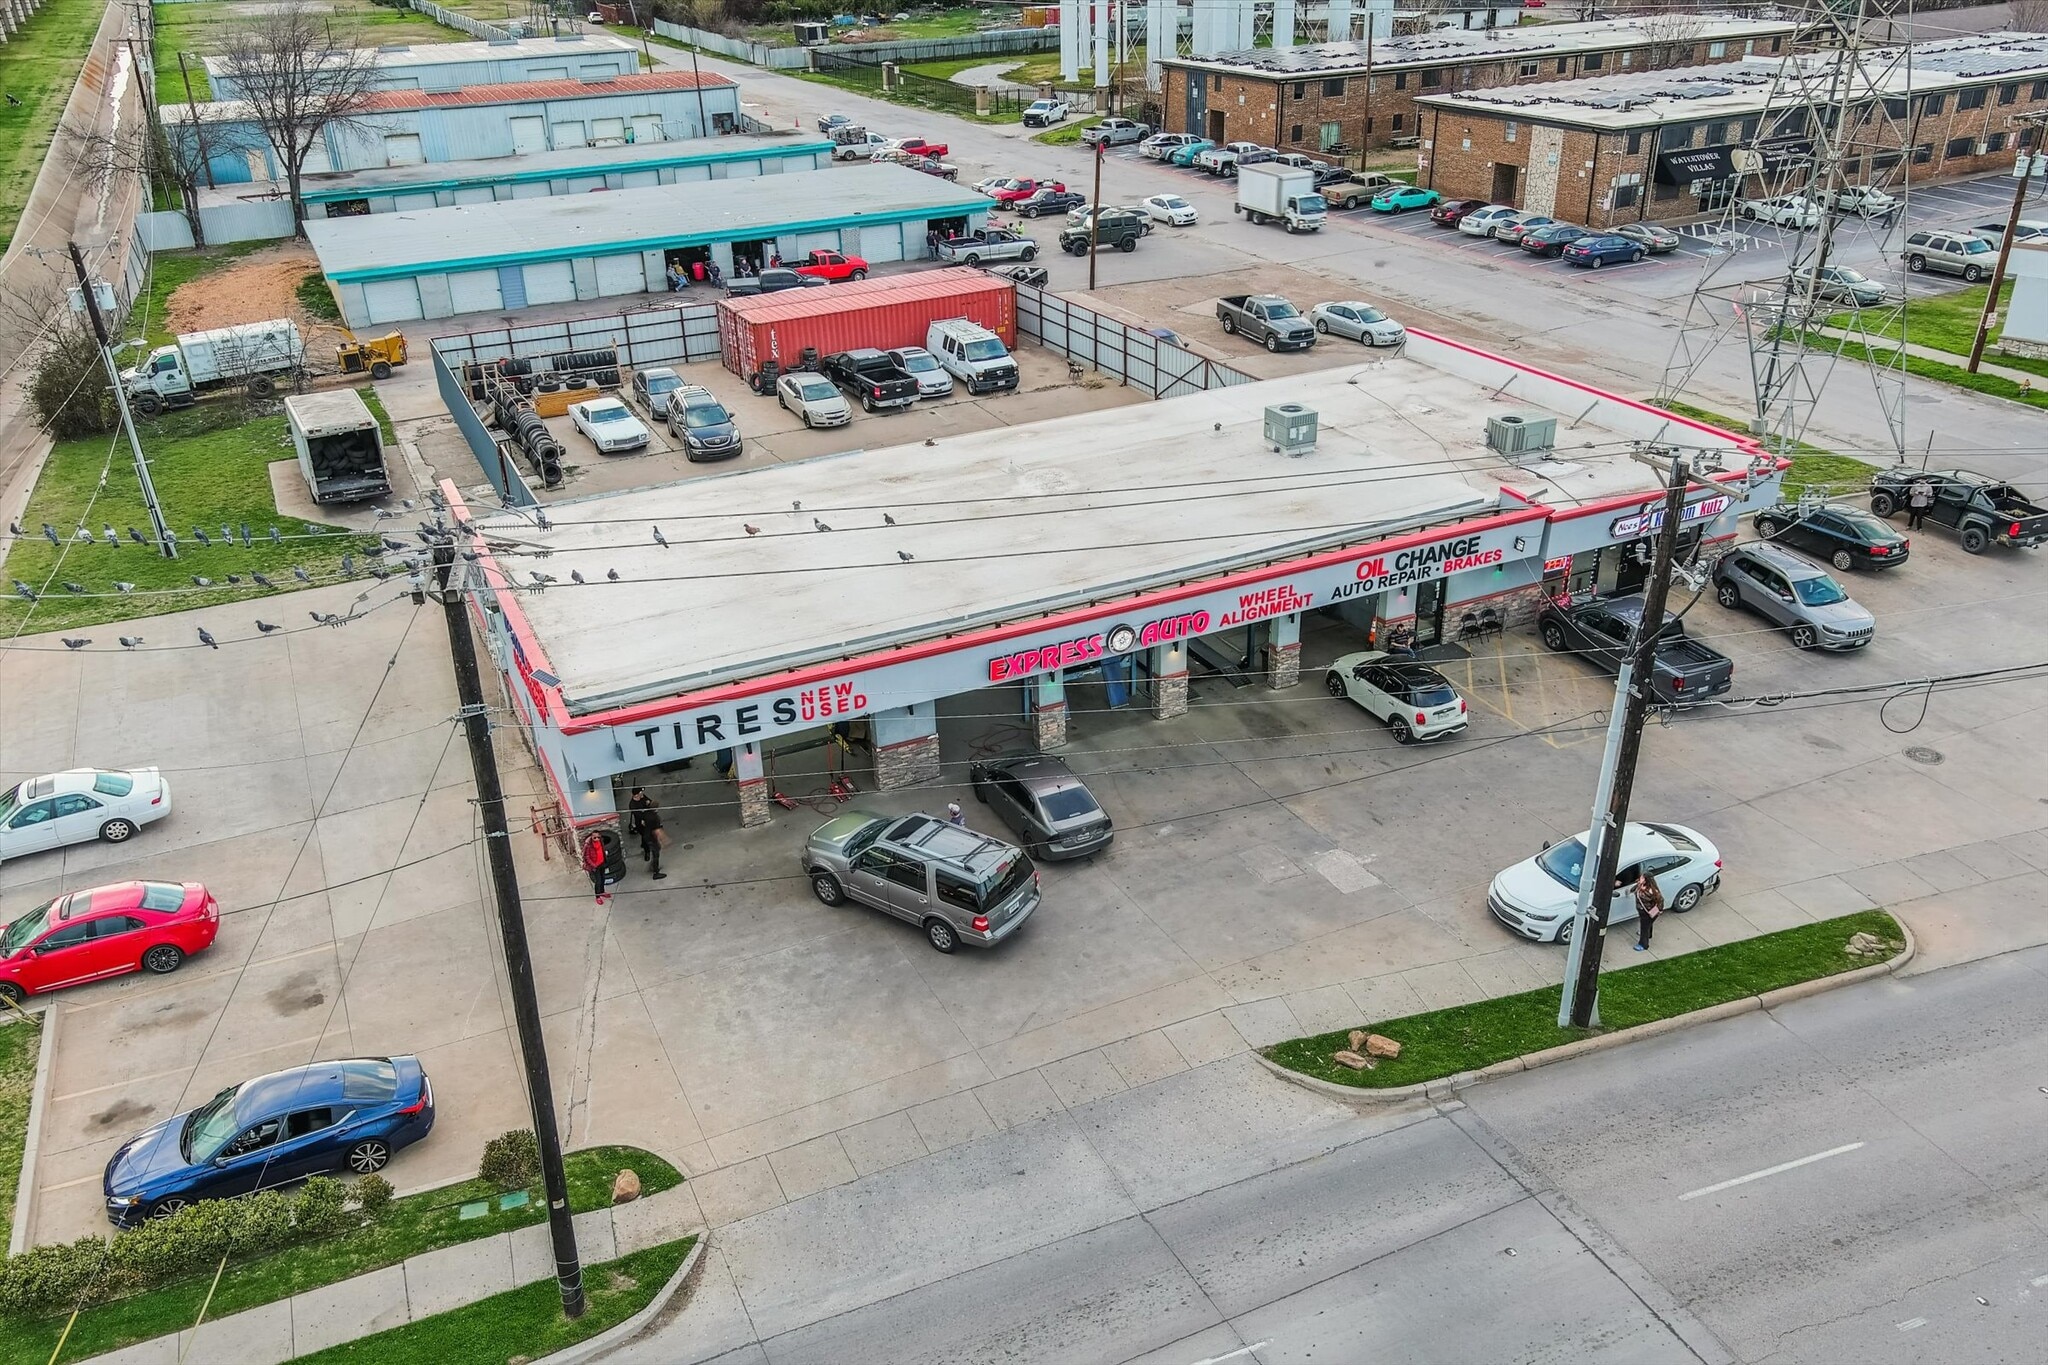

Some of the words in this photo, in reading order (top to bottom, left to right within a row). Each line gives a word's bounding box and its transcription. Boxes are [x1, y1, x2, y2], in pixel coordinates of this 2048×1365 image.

[1669, 152, 1720, 165] WATERTOWER
[1687, 162, 1715, 173] VILLAS
[770, 328, 780, 359] tex
[1699, 498, 1724, 516] kutz
[1356, 557, 1389, 580] OIL
[1395, 535, 1481, 571] CHANGE
[1331, 579, 1373, 600] AUTO
[1378, 565, 1431, 589] REPAIR
[1443, 549, 1503, 574] BRAKES
[1219, 593, 1314, 627] ALIGNMENT
[1238, 584, 1298, 609] WHEEL
[988, 634, 1104, 682] EXPRESS
[1140, 609, 1211, 649] AUTO
[800, 681, 854, 706] NEW
[801, 694, 867, 721] USED
[635, 697, 797, 757] TIRES
